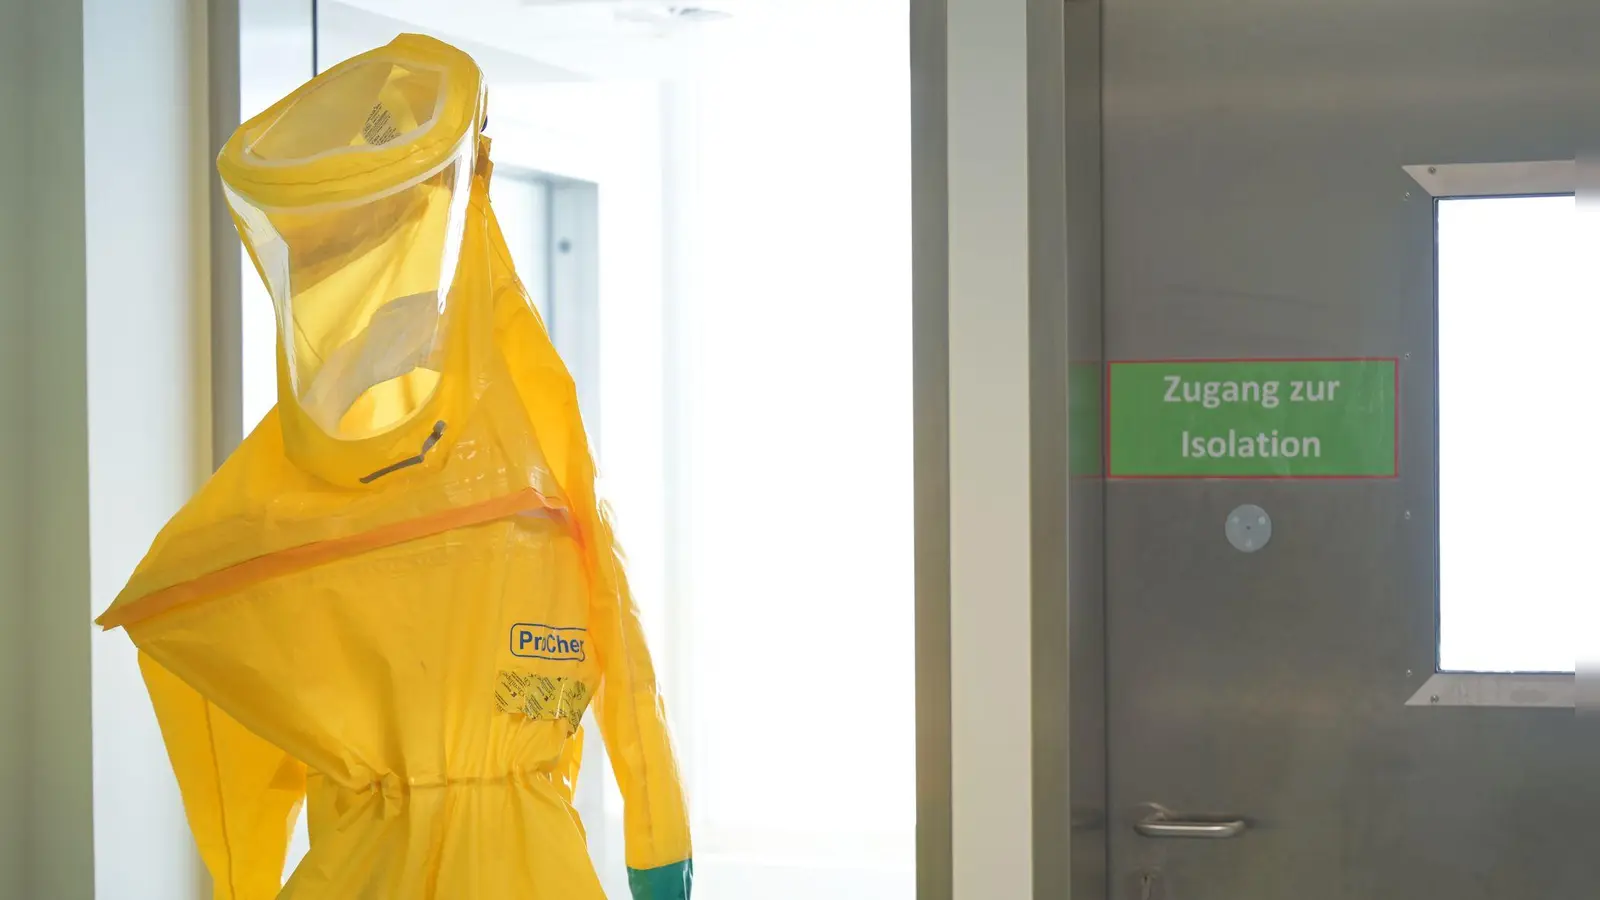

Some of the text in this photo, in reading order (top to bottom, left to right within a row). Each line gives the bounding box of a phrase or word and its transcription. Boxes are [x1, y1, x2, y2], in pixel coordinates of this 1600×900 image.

[1163, 375, 1341, 409] Zugang zur
[1181, 429, 1321, 458] Isolation
